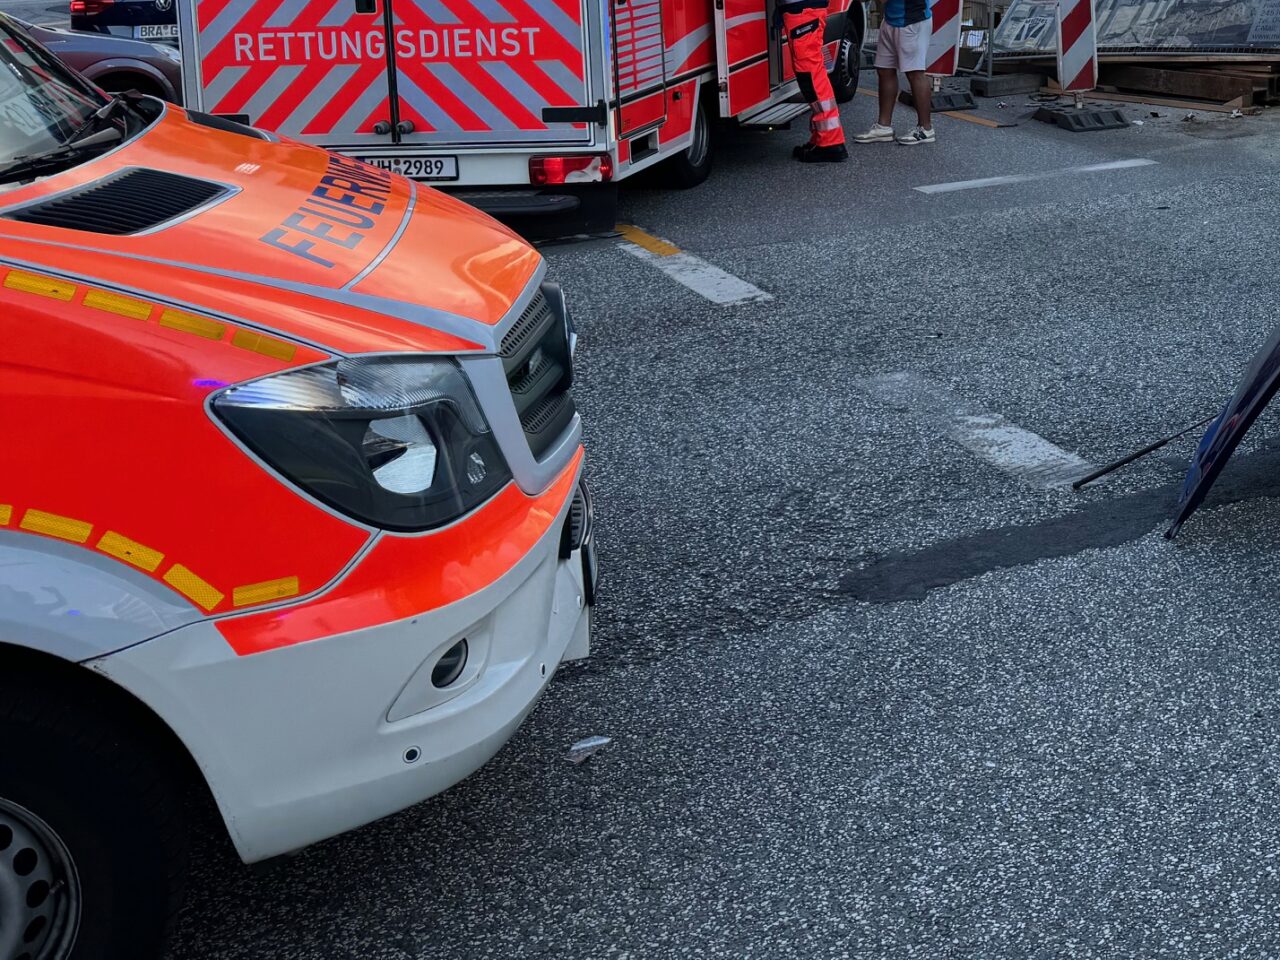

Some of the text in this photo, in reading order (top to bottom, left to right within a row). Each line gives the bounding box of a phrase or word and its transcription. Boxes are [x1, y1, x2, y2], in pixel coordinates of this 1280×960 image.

[140, 25, 163, 37] BRA
[234, 27, 540, 61] RETTUNGSDIENST
[402, 159, 444, 177] 2989
